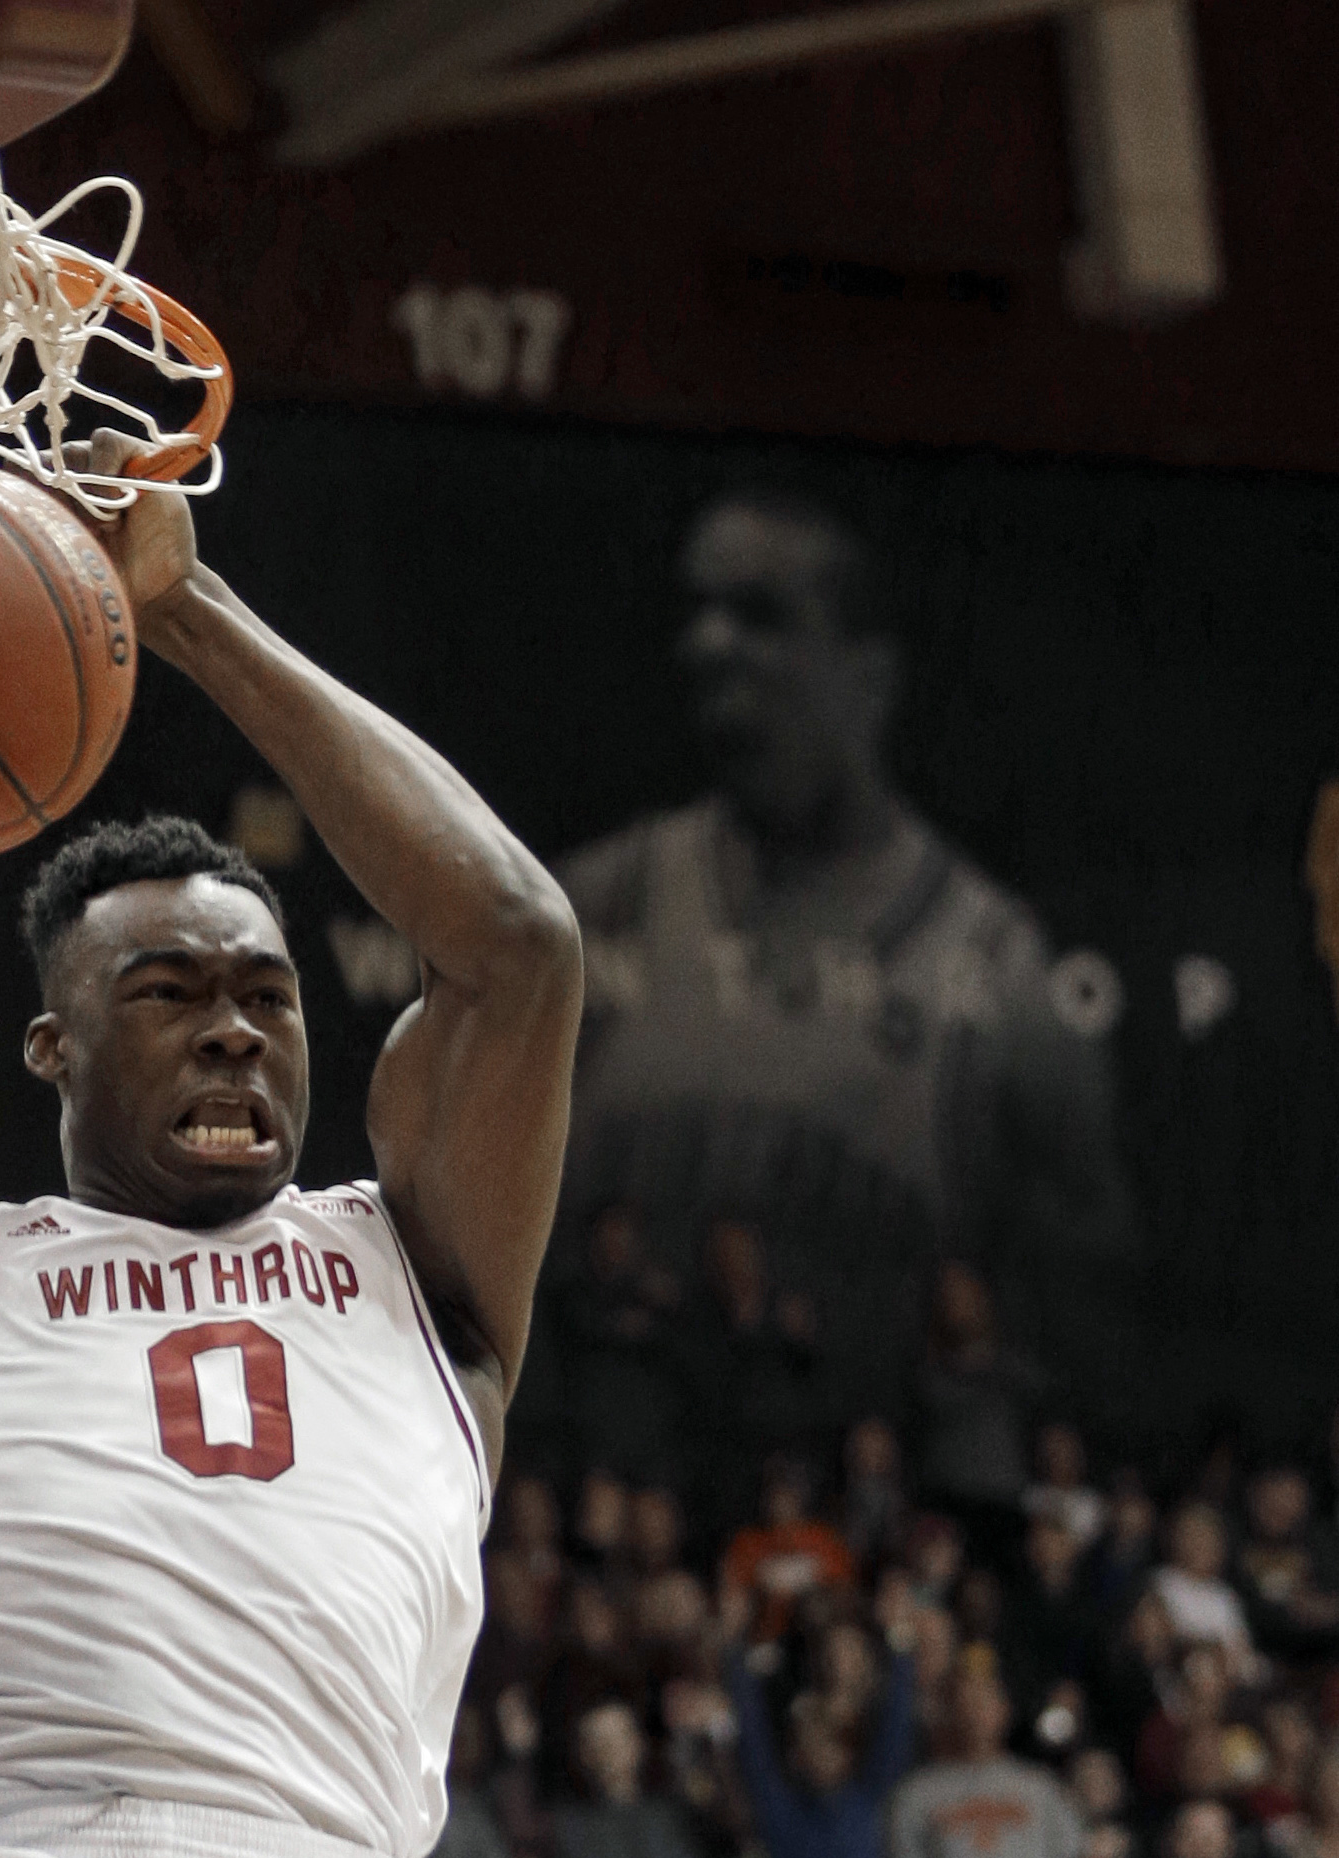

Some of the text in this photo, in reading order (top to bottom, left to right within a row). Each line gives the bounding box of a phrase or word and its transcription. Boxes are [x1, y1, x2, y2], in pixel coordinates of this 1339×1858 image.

[394, 286, 569, 396] 107
[37, 1238, 360, 1320] WINTHROP
[147, 1318, 295, 1483] 0
